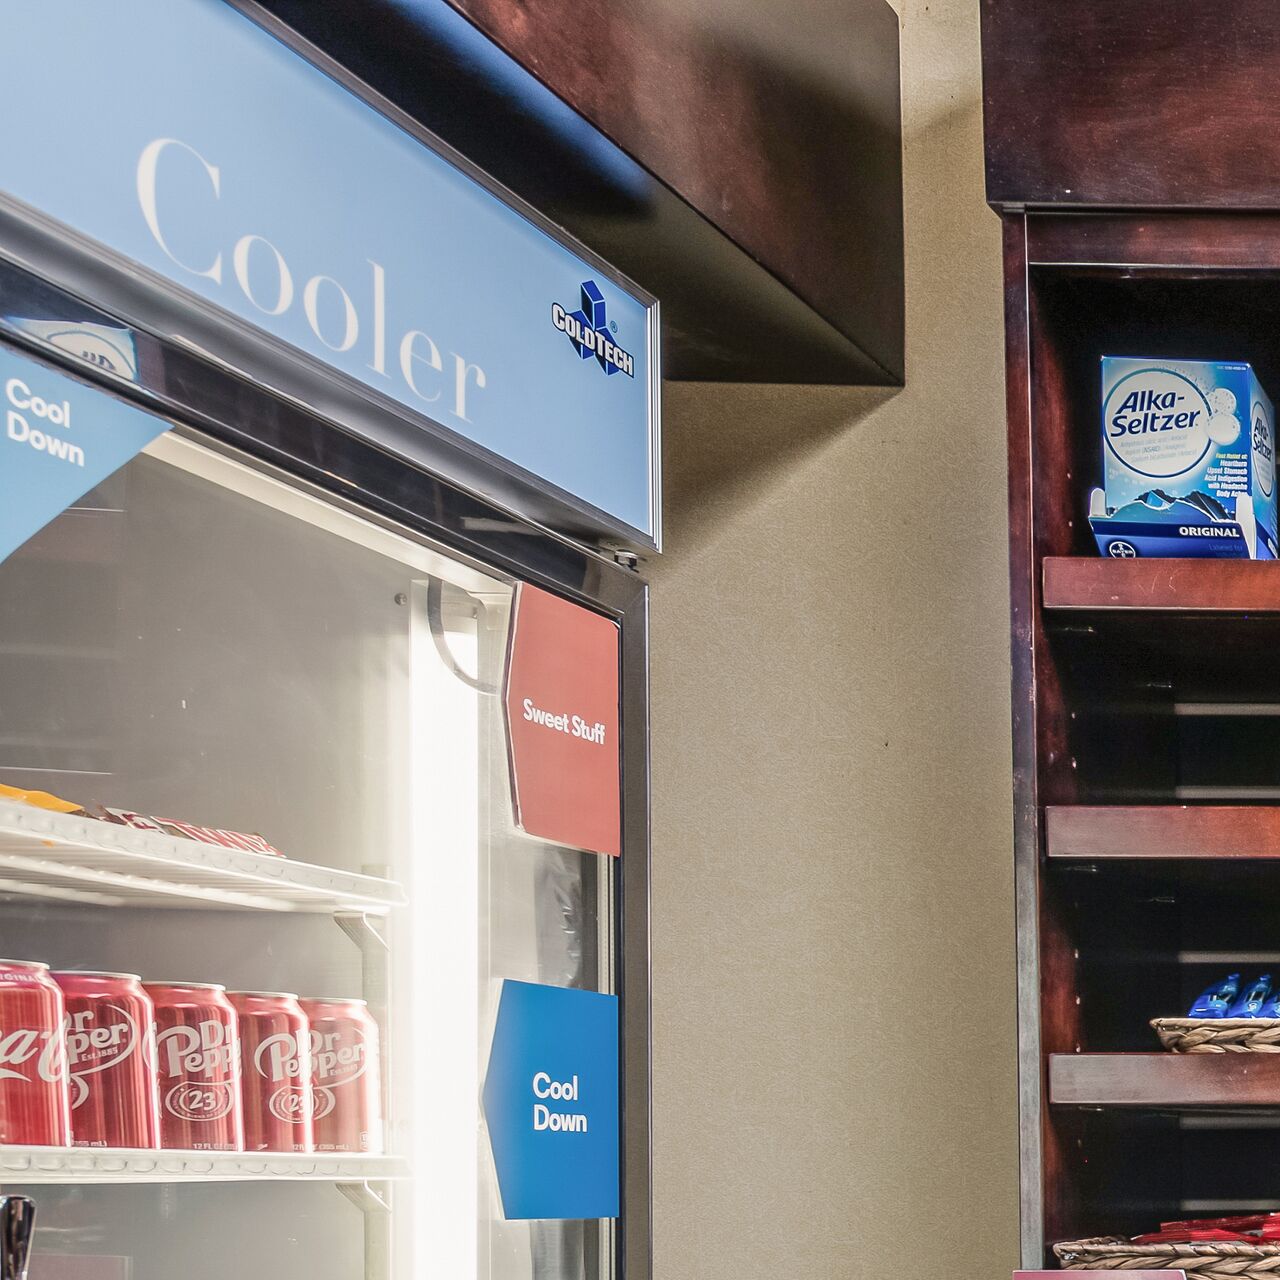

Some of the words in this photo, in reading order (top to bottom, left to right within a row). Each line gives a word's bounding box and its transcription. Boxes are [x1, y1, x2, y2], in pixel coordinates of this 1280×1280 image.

[136, 137, 486, 424] Cooler
[551, 301, 635, 378] COLDTECH
[6, 377, 71, 429] Cool
[1116, 390, 1184, 414] Alka-
[6, 410, 86, 467] Down
[1110, 410, 1200, 437] Seltzer
[1221, 482, 1248, 490] Headache
[1224, 467, 1248, 475] Stomach
[1179, 526, 1240, 538] ORIGINAL
[523, 697, 569, 735] Sweet
[571, 713, 607, 745] Stuff
[189, 1084, 215, 1110] 23
[533, 1071, 578, 1101] Cool
[533, 1102, 587, 1133] Down
